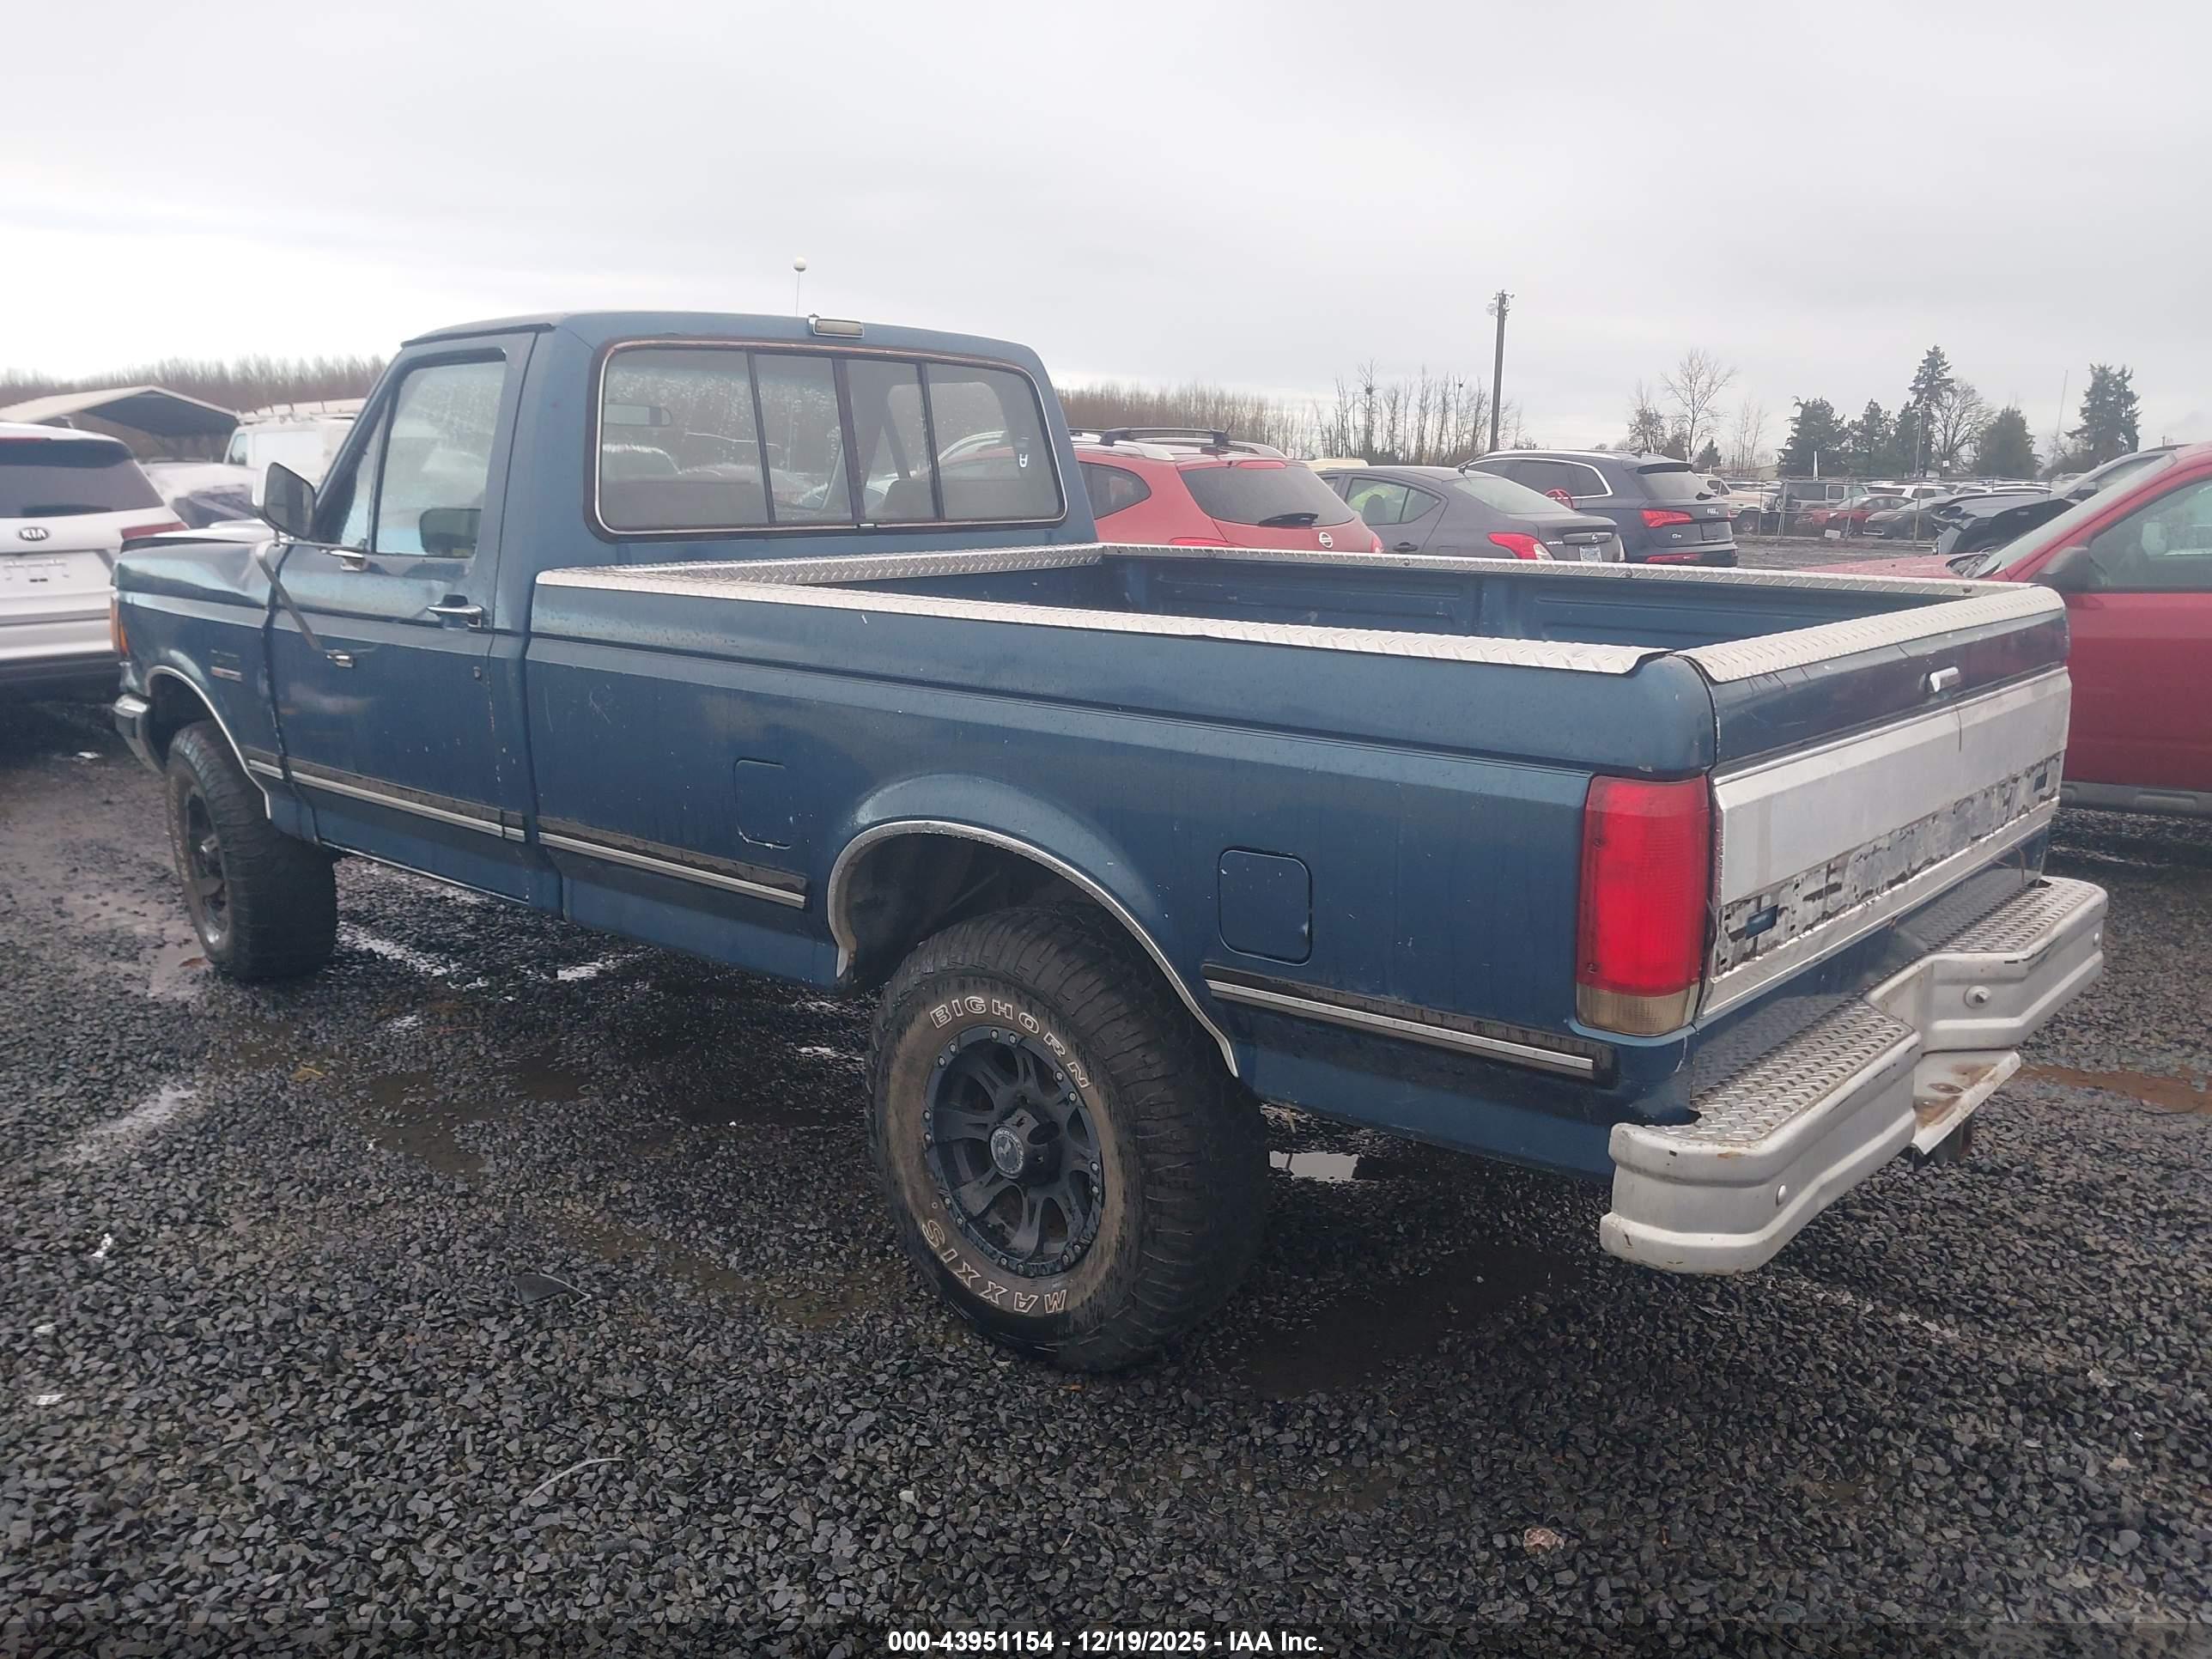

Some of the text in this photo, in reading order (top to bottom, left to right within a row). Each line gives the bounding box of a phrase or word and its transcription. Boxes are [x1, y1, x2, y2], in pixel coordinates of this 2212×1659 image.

[21, 529, 46, 539] KIA
[930, 996, 1091, 1088] BIGHORN
[922, 1219, 1067, 1314] MAXXIS
